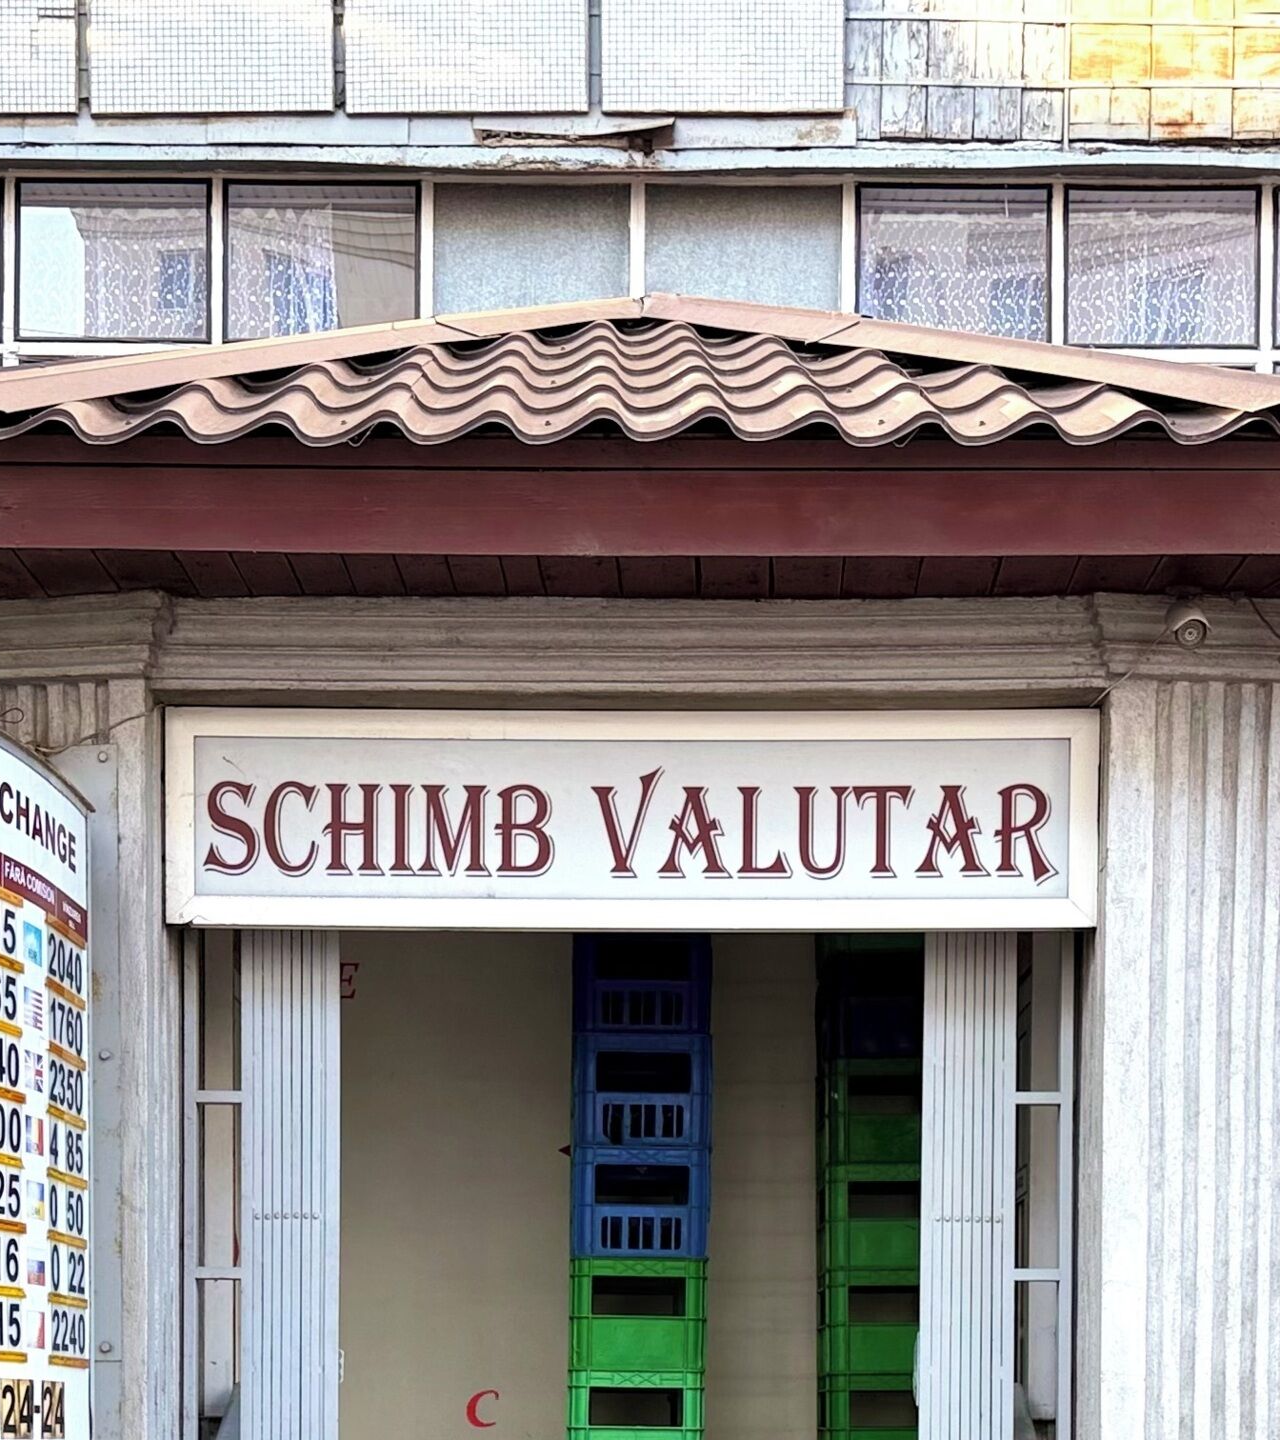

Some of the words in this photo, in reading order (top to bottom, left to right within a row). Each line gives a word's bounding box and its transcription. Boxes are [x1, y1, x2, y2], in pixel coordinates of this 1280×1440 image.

[203, 779, 555, 879] SCHIMB
[590, 766, 1059, 887] VALUTAR
[48, 932, 83, 995] 2040
[50, 997, 83, 1057] 1760
[49, 1059, 84, 1116] 2350
[52, 1310, 86, 1355] 2240
[1, 1384, 65, 1434] 24-24
[465, 1389, 500, 1428] C
